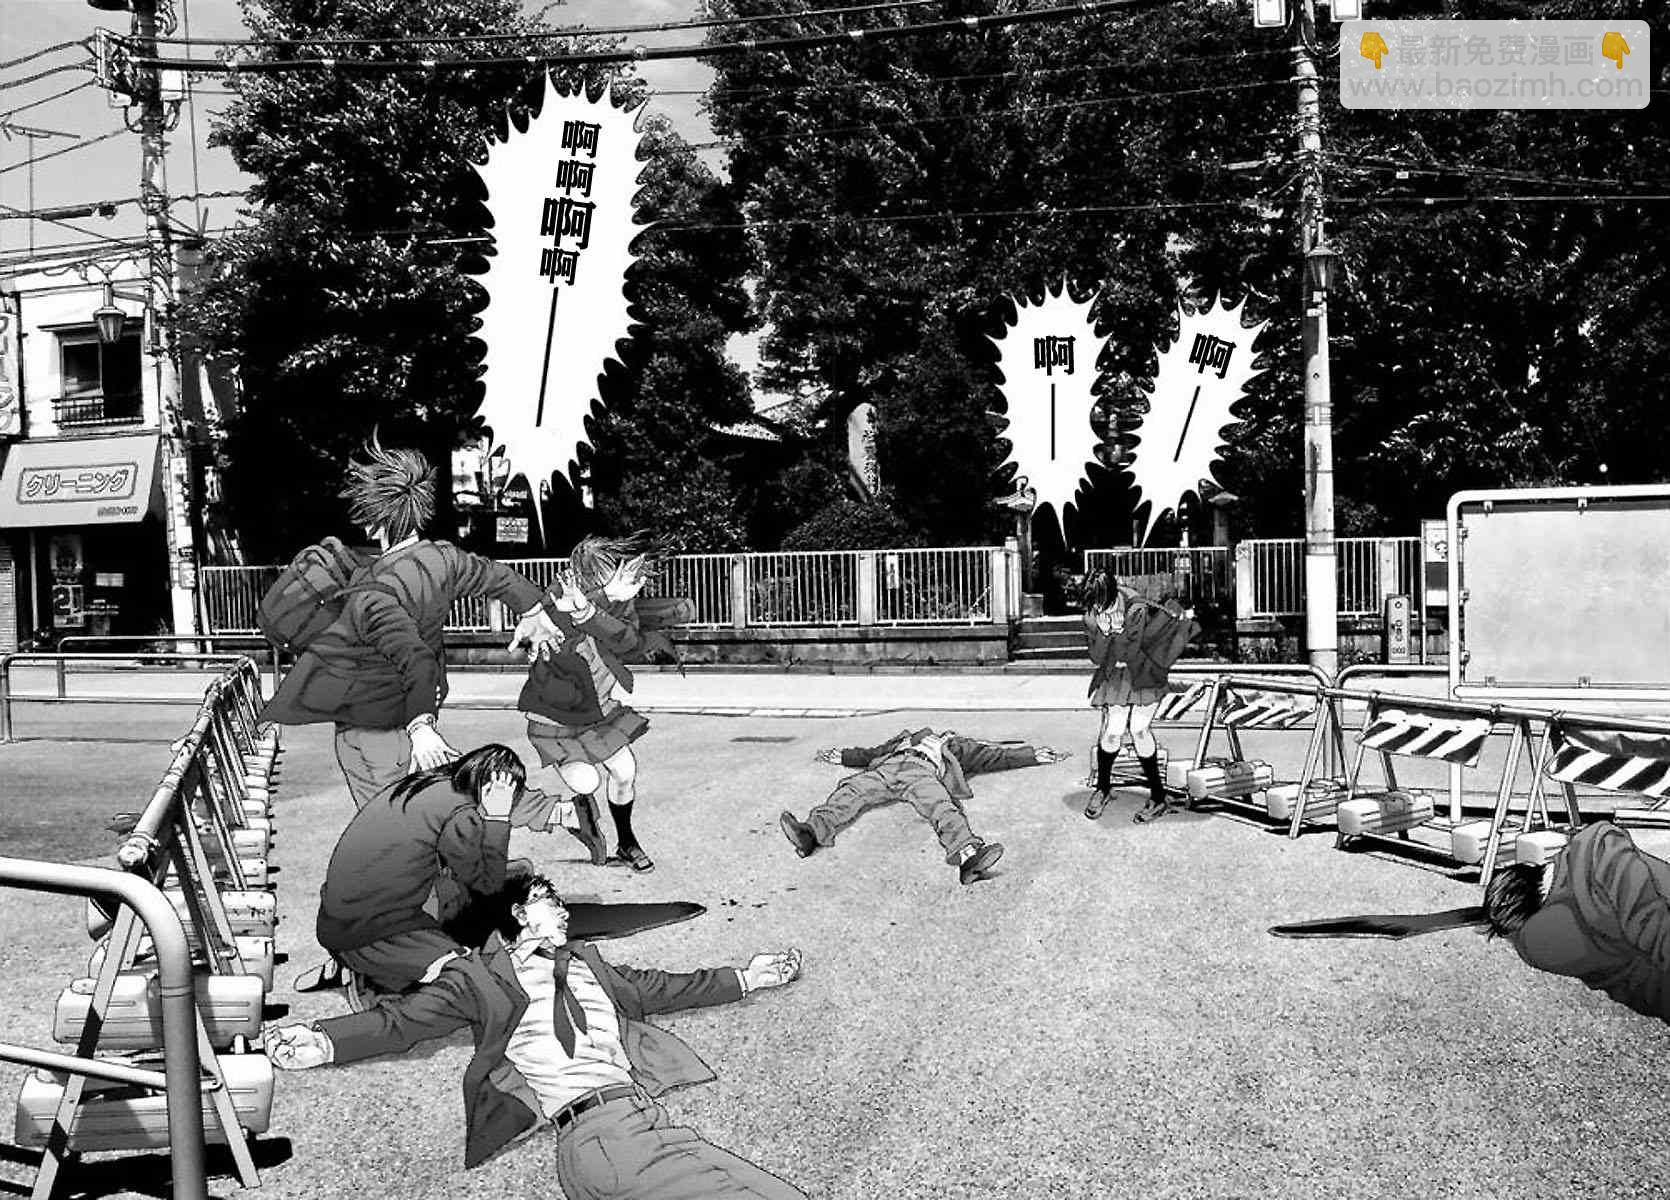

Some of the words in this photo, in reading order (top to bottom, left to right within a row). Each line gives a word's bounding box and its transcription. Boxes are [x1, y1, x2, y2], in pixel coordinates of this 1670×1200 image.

[26, 469, 129, 497] クリーニング
